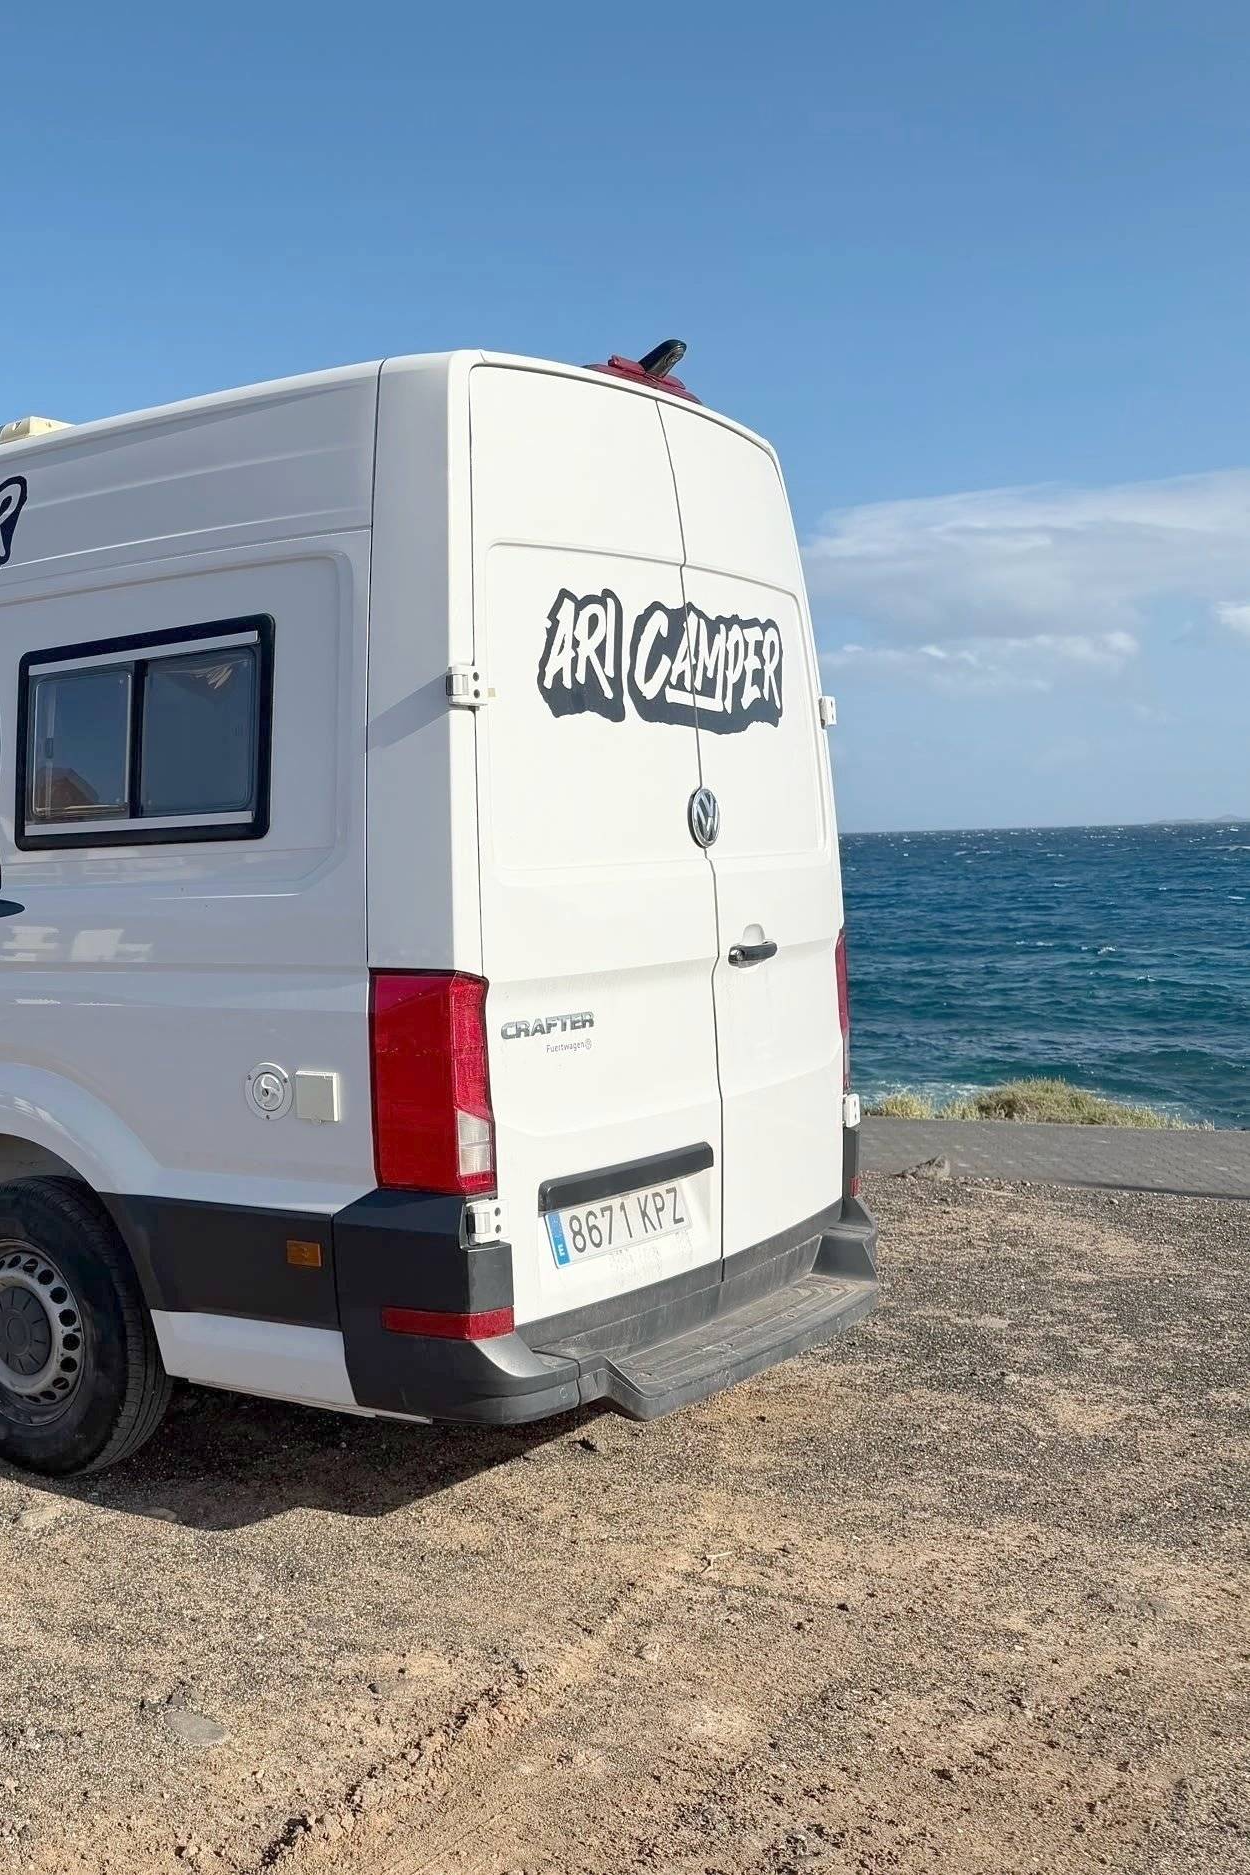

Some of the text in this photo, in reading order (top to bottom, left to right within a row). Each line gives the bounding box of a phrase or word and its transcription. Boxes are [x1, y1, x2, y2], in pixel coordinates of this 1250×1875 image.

[542, 596, 782, 716] ARI CAMPER
[500, 1011, 595, 1040] CRAFTER
[568, 1186, 685, 1254] 8671 KPZ
[557, 1244, 566, 1257] E
